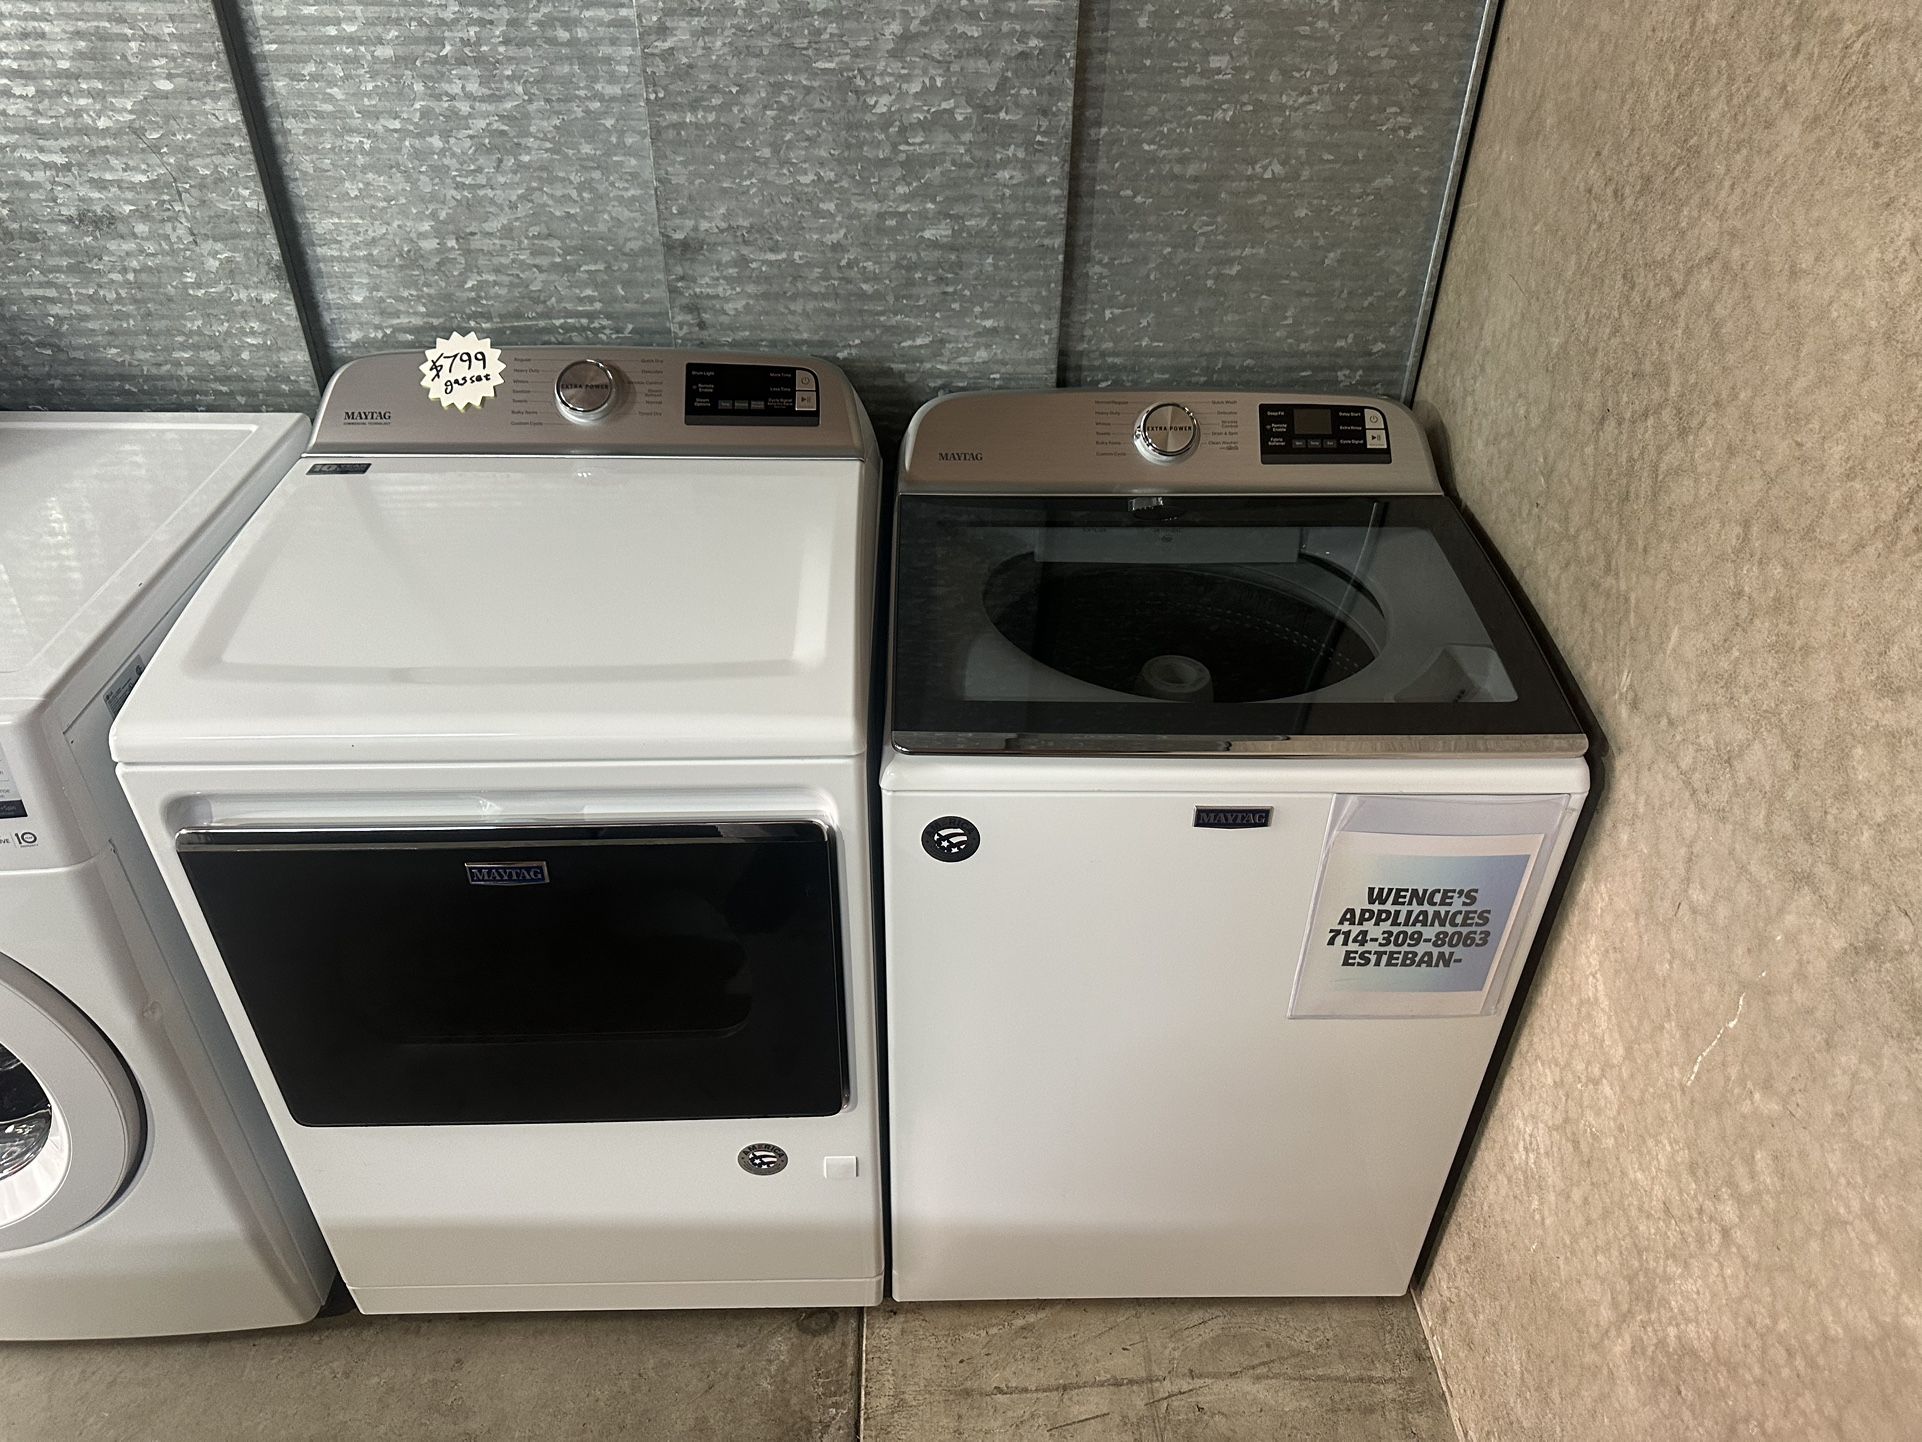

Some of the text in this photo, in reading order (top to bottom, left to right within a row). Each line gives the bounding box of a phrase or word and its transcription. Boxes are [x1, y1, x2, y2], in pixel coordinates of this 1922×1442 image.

[429, 351, 487, 382] $799
[344, 411, 392, 420] MAYTAG
[938, 452, 984, 462] MAYTAG
[1200, 812, 1266, 824] MAYTAG
[14, 832, 38, 844] 10
[472, 868, 542, 880] MAYTAG
[1367, 886, 1478, 906] WENCE'S
[1338, 908, 1491, 927] APPLIANCES
[1326, 929, 1490, 948] 714-309-8063
[1341, 950, 1462, 968] ESTEBAN-
[742, 1144, 784, 1158] AMERICA
